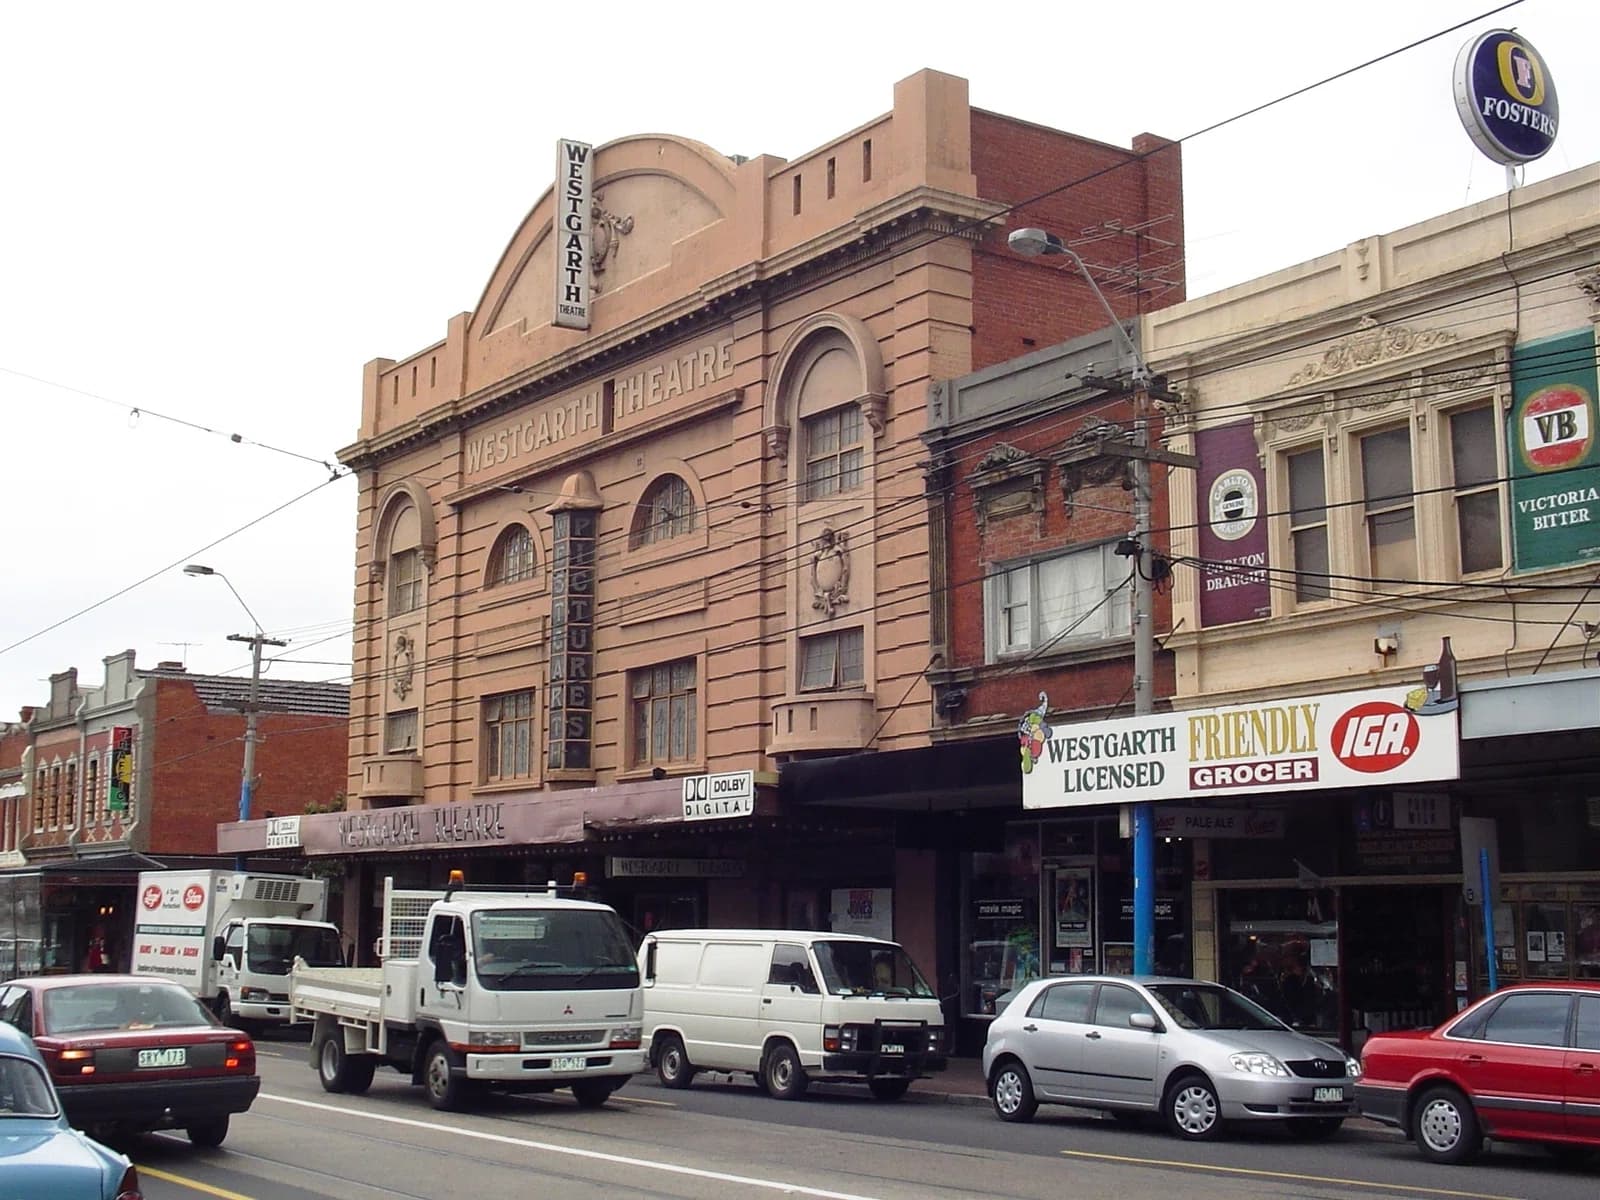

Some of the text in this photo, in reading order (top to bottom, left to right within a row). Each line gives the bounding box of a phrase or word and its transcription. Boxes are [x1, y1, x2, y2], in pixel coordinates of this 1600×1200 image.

[565, 143, 588, 303] WESTGARTH
[559, 304, 586, 318] THEATRE
[466, 339, 737, 475] WESTGARTH THEATRE
[1534, 409, 1578, 444] VB
[1518, 487, 1600, 513] VICTORIA
[1533, 508, 1591, 531] BITTER
[566, 519, 591, 738] PICTURES
[1047, 726, 1176, 764] WESTGARTH
[1188, 702, 1321, 763] FRIENDLY
[714, 778, 746, 793] DOLBY
[1063, 761, 1165, 794] LICENSED
[1193, 760, 1314, 787] GROCER
[685, 800, 750, 816] DIGITAL
[338, 802, 505, 849] WESTGARTH THEATRE
[267, 836, 298, 847] DIGITAL
[979, 903, 1023, 915] movie magic
[140, 1050, 184, 1065] SRY 173
